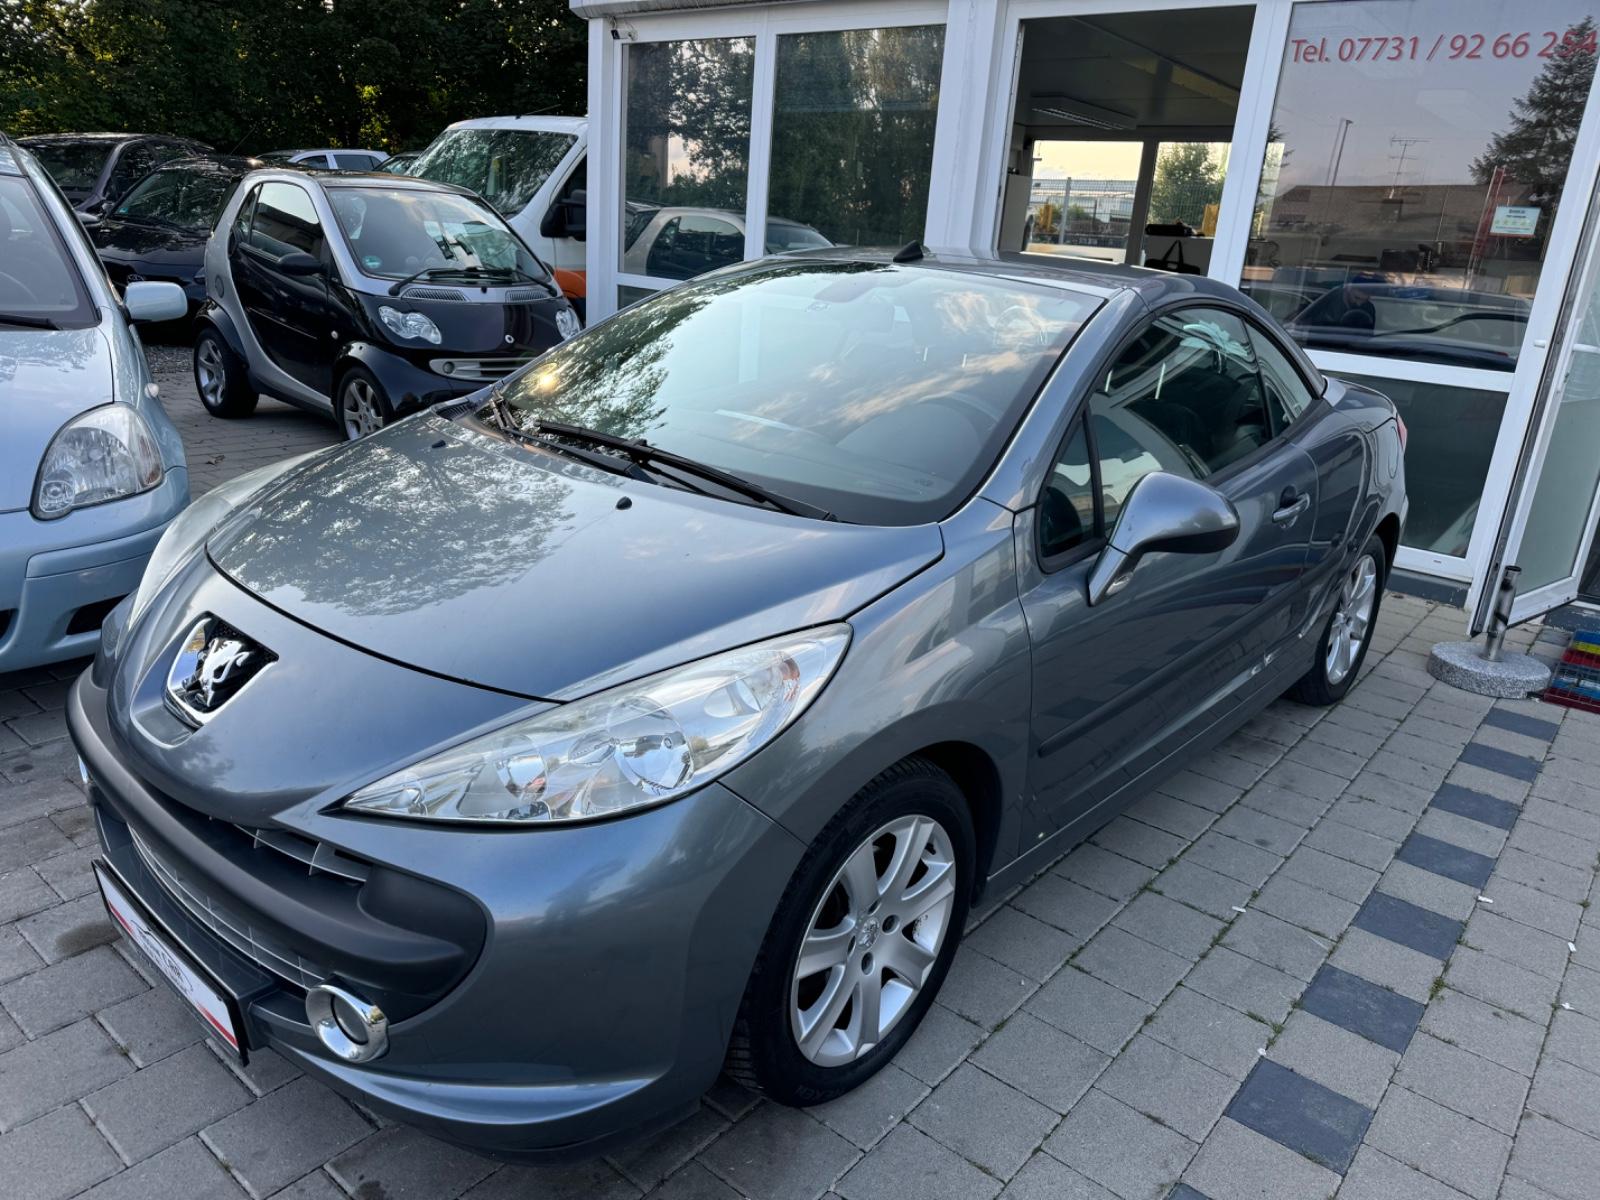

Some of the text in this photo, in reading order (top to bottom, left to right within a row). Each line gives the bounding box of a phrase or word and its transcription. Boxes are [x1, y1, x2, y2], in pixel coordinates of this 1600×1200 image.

[1291, 29, 1598, 63] Tel. 07731 / 92 66 254
